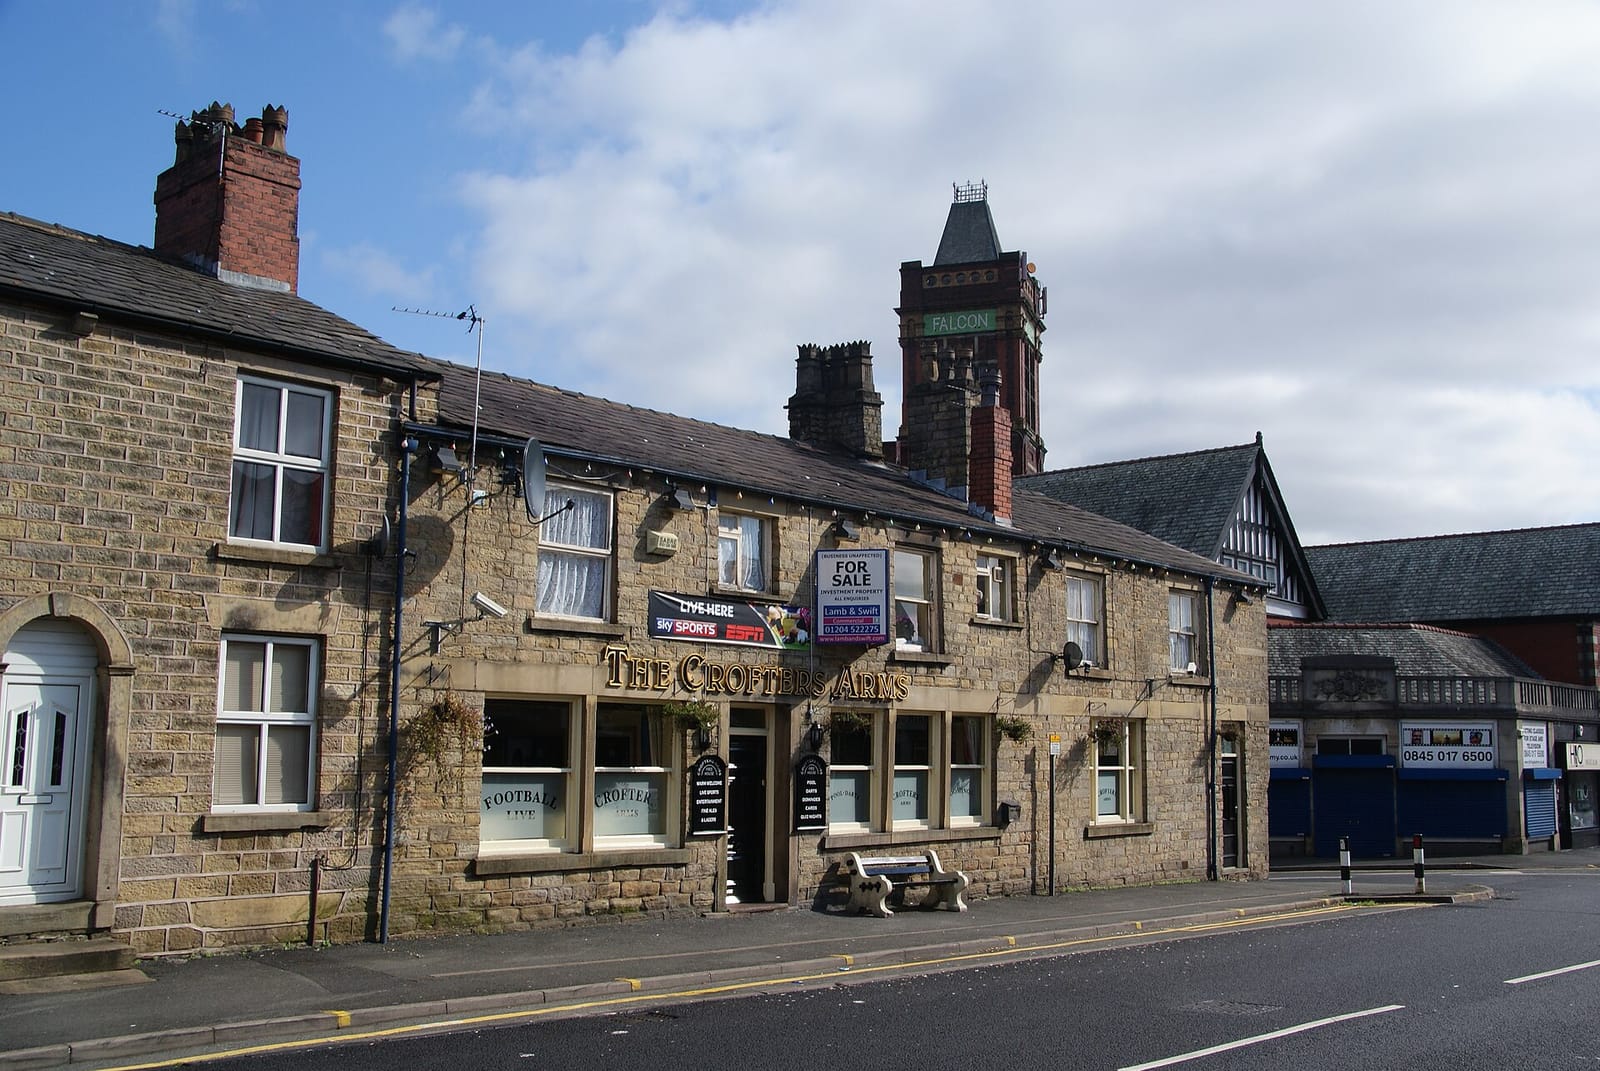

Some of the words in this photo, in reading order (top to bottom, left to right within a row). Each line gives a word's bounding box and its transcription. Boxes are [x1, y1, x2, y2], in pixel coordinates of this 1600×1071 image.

[932, 312, 988, 331] FALCON
[836, 561, 868, 573] FOR
[832, 574, 872, 587] SALE
[680, 600, 705, 615] LIVE
[706, 603, 734, 618] HERE
[825, 607, 847, 616] Lamb
[849, 606, 856, 615] &
[858, 606, 879, 616] Swift
[656, 618, 673, 633] sky
[675, 621, 716, 636] SPORTS
[725, 624, 764, 641] ESPN
[825, 625, 849, 634] 01204
[850, 625, 879, 633] 522275
[605, 645, 672, 690] THE
[681, 653, 827, 697] CROFTERS
[834, 664, 912, 700] ARMS
[1403, 751, 1434, 762] 0845
[1437, 751, 1459, 762] 017
[1462, 751, 1493, 762] 6500
[482, 790, 558, 811] FOOTBALL
[506, 809, 537, 821] LIVE
